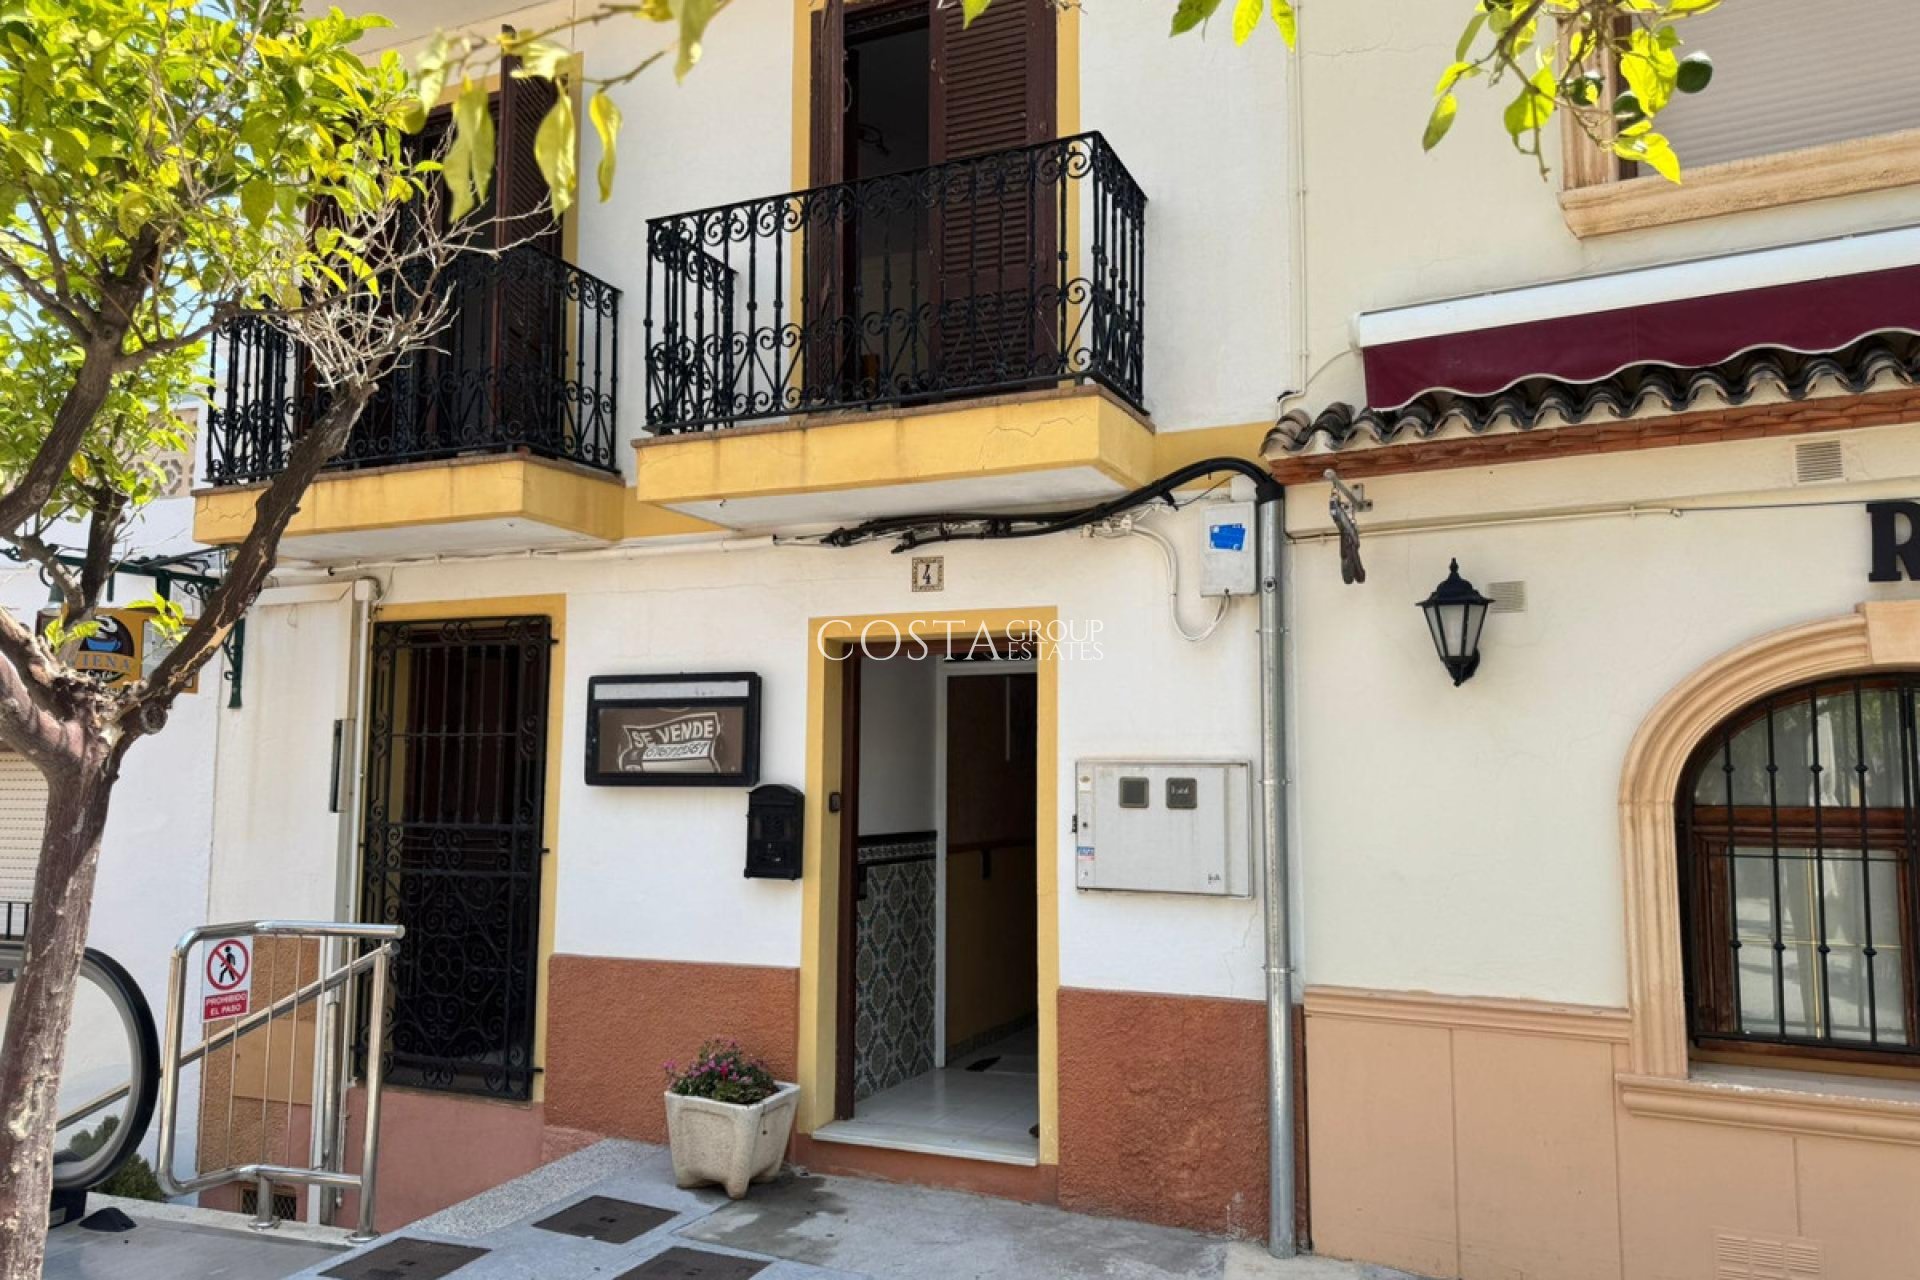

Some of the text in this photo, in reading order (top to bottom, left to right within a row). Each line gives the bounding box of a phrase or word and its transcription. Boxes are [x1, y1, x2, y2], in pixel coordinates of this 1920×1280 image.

[921, 564, 932, 585] 4
[631, 720, 714, 748] SE VENDE
[206, 992, 246, 1006] PROHIBIDO
[210, 1003, 241, 1016] EL PASO
